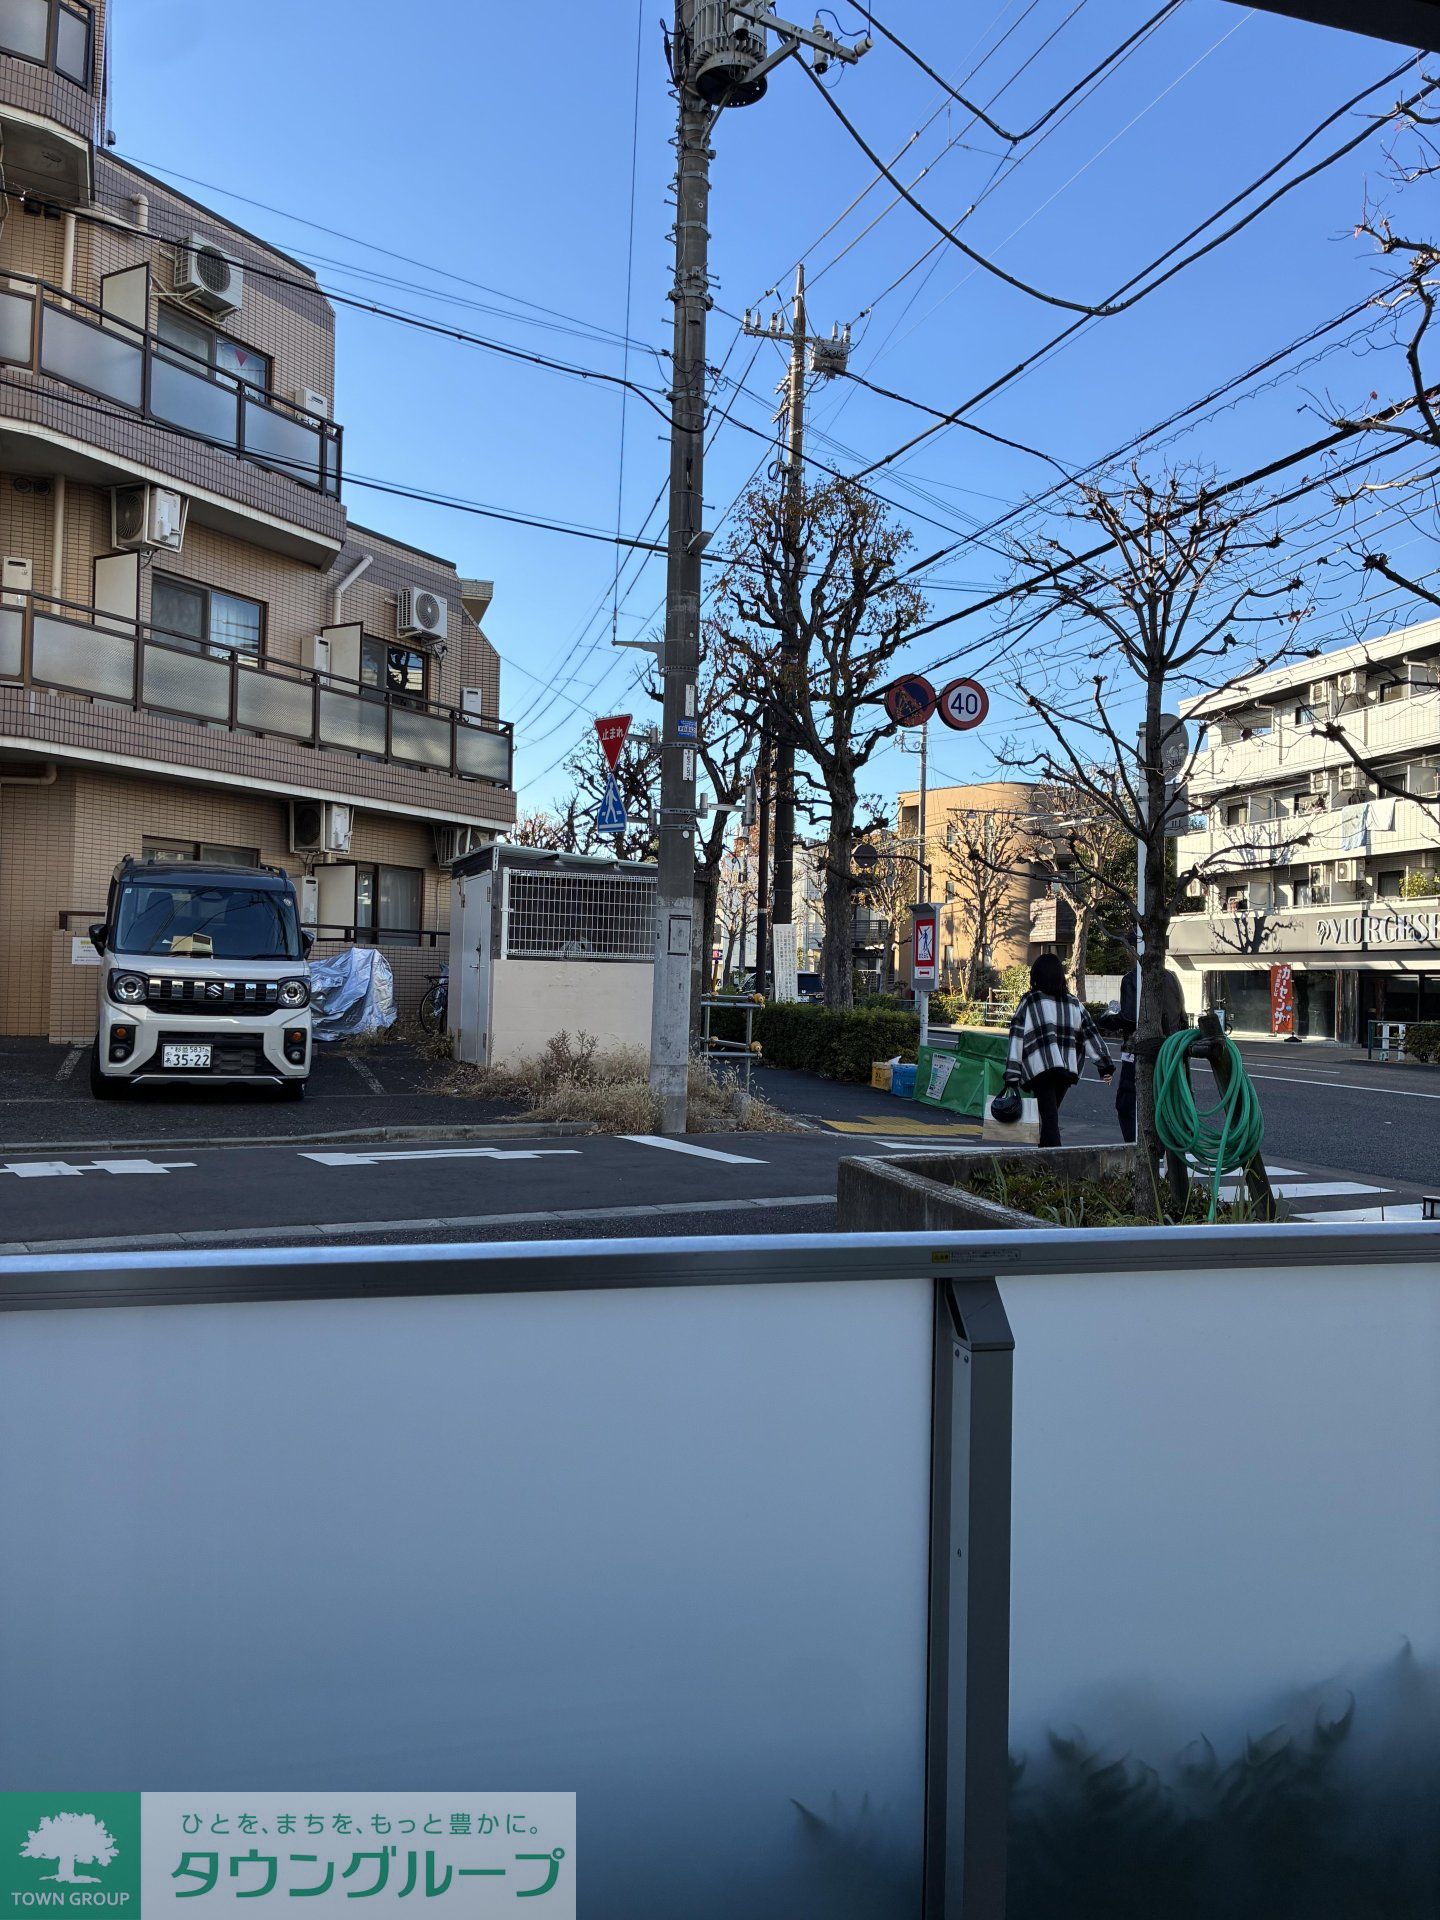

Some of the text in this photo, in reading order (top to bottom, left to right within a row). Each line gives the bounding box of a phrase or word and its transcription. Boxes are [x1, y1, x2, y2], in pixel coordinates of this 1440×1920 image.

[950, 693, 978, 715] 40
[602, 726, 625, 741] 止まれ
[1274, 966, 1291, 1031] カーセンサー
[173, 1054, 210, 1067] 35-22
